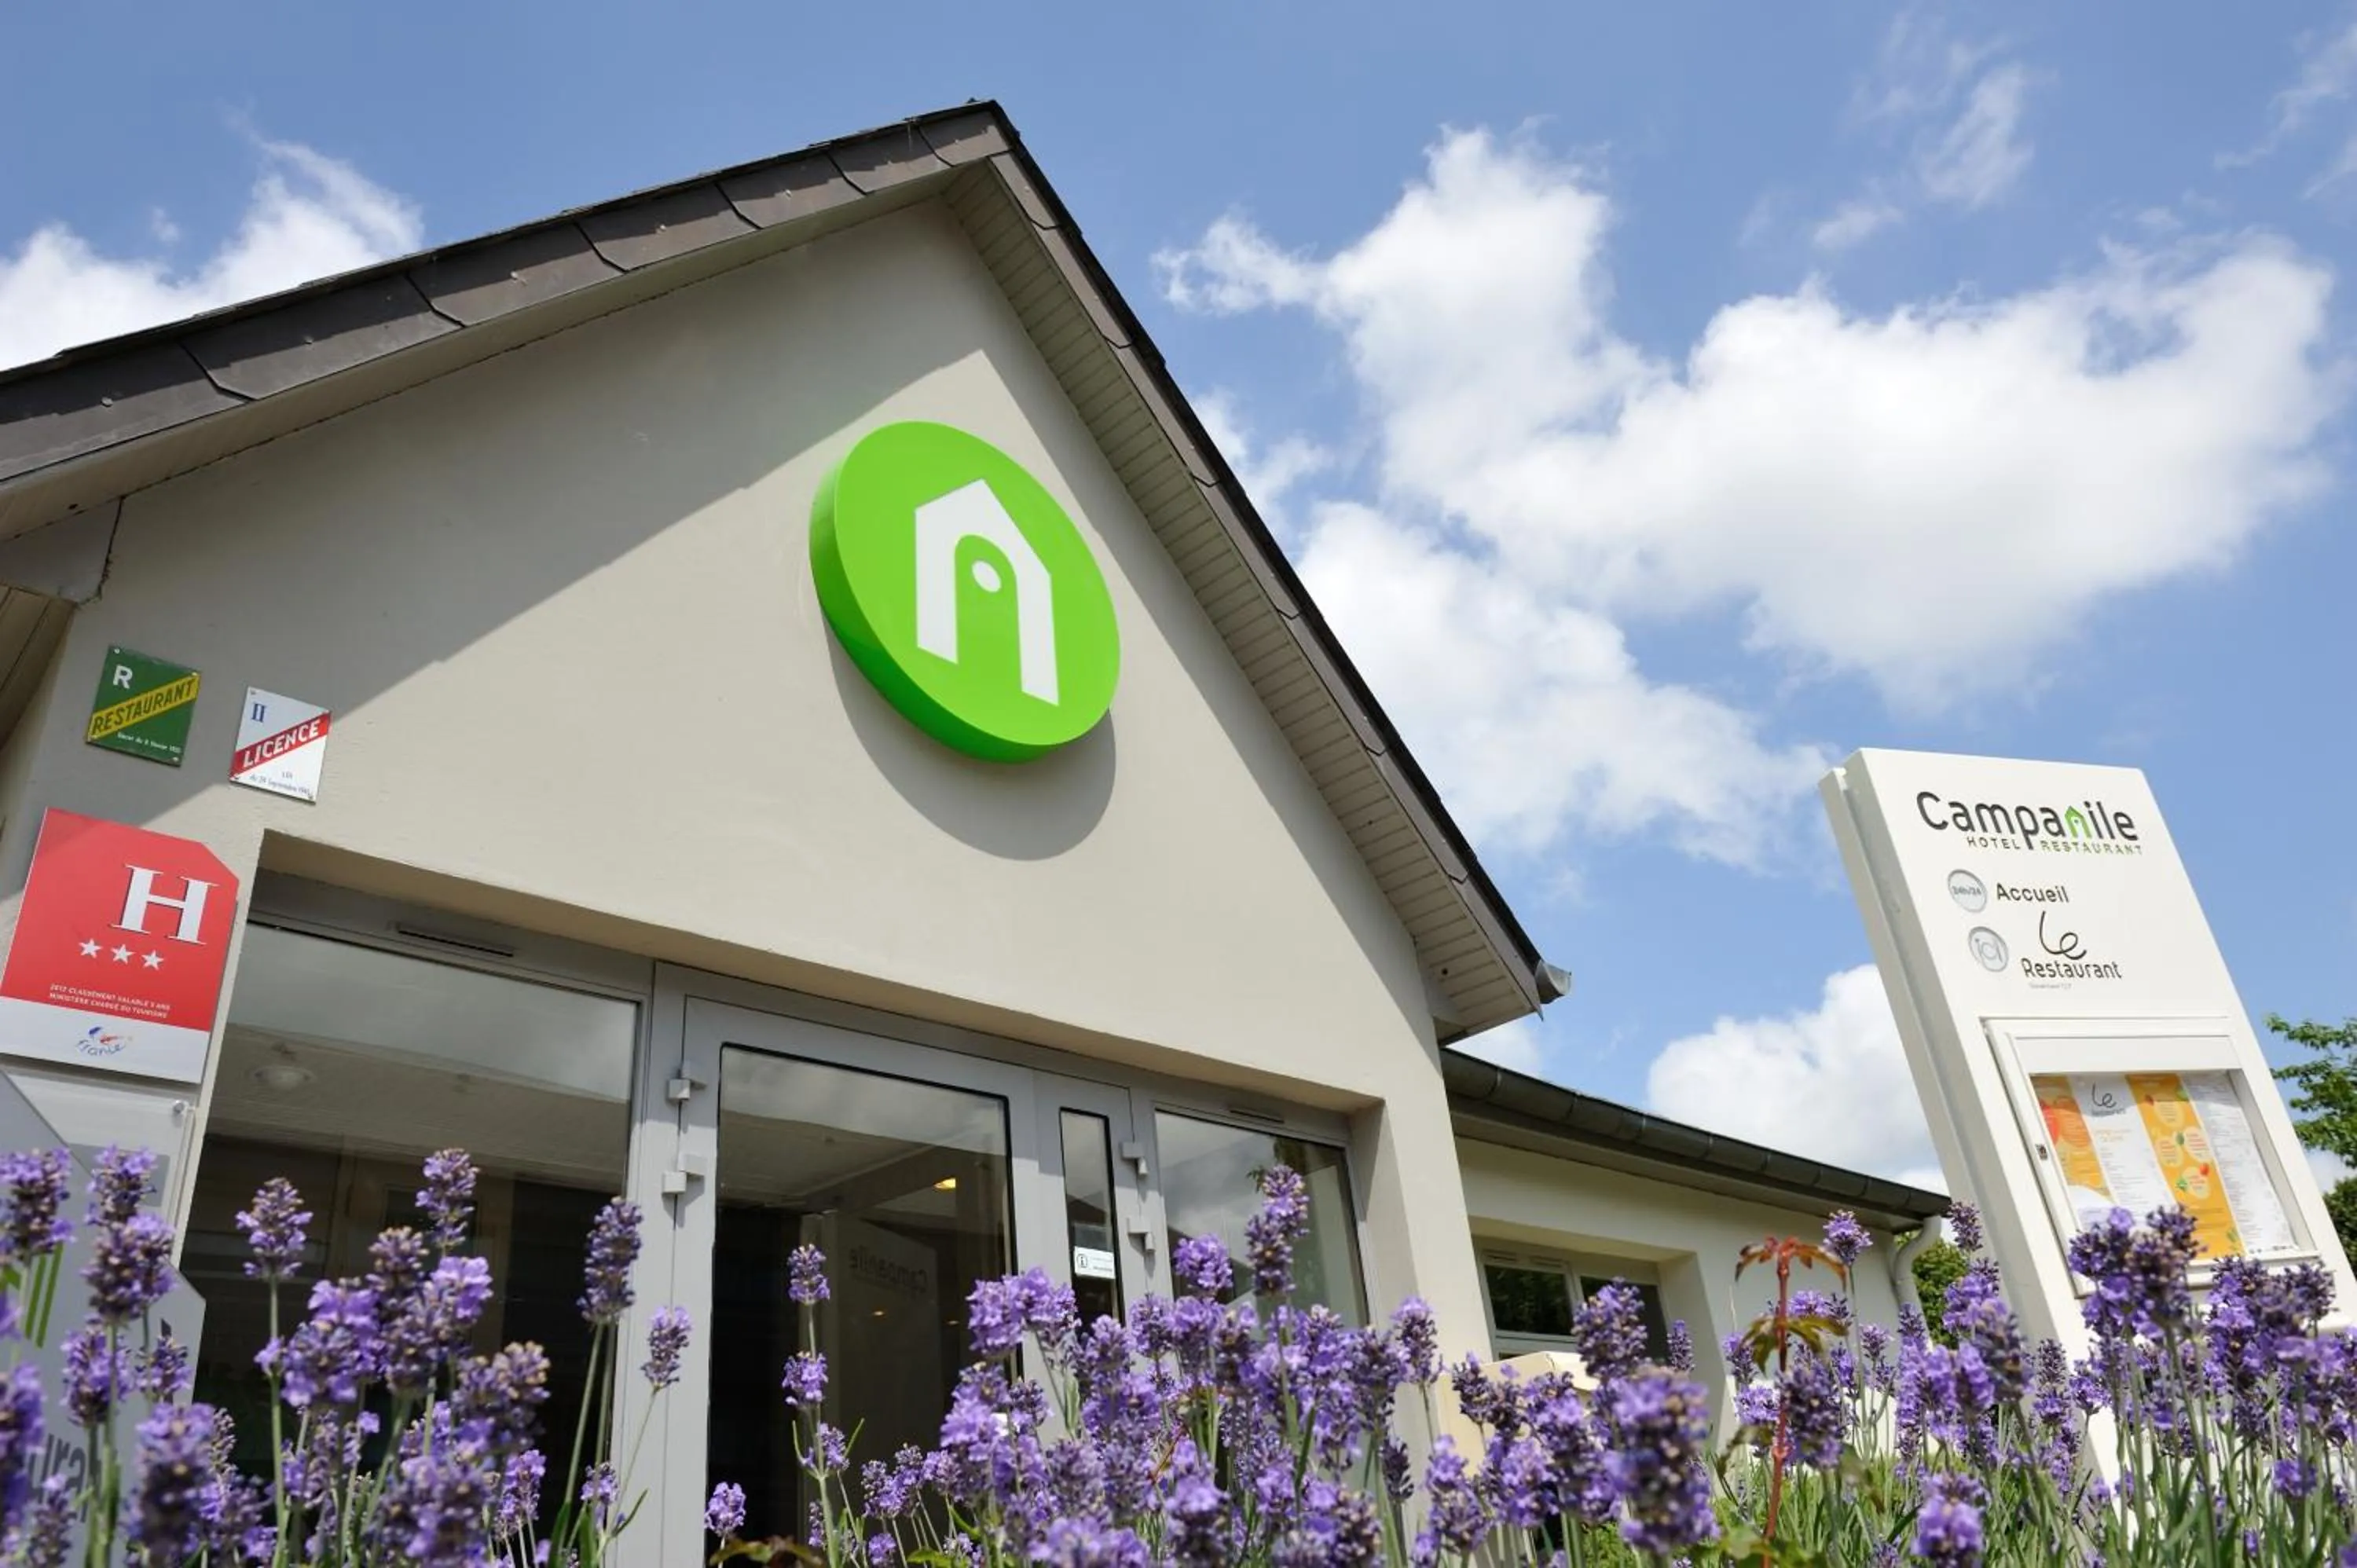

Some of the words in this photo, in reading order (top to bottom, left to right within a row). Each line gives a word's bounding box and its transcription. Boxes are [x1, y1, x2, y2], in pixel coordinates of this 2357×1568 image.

[113, 665, 133, 689] R
[92, 677, 196, 736] RESTAURANT
[244, 718, 321, 768] LICENCE
[1916, 791, 2139, 850] Campanile
[1967, 836, 2022, 851] HOTEL
[2040, 840, 2143, 855] RESTAURANT
[109, 863, 220, 946] H
[1996, 882, 2070, 903] Accueil
[2039, 910, 2088, 961] Le
[2020, 957, 2123, 979] Restaurant
